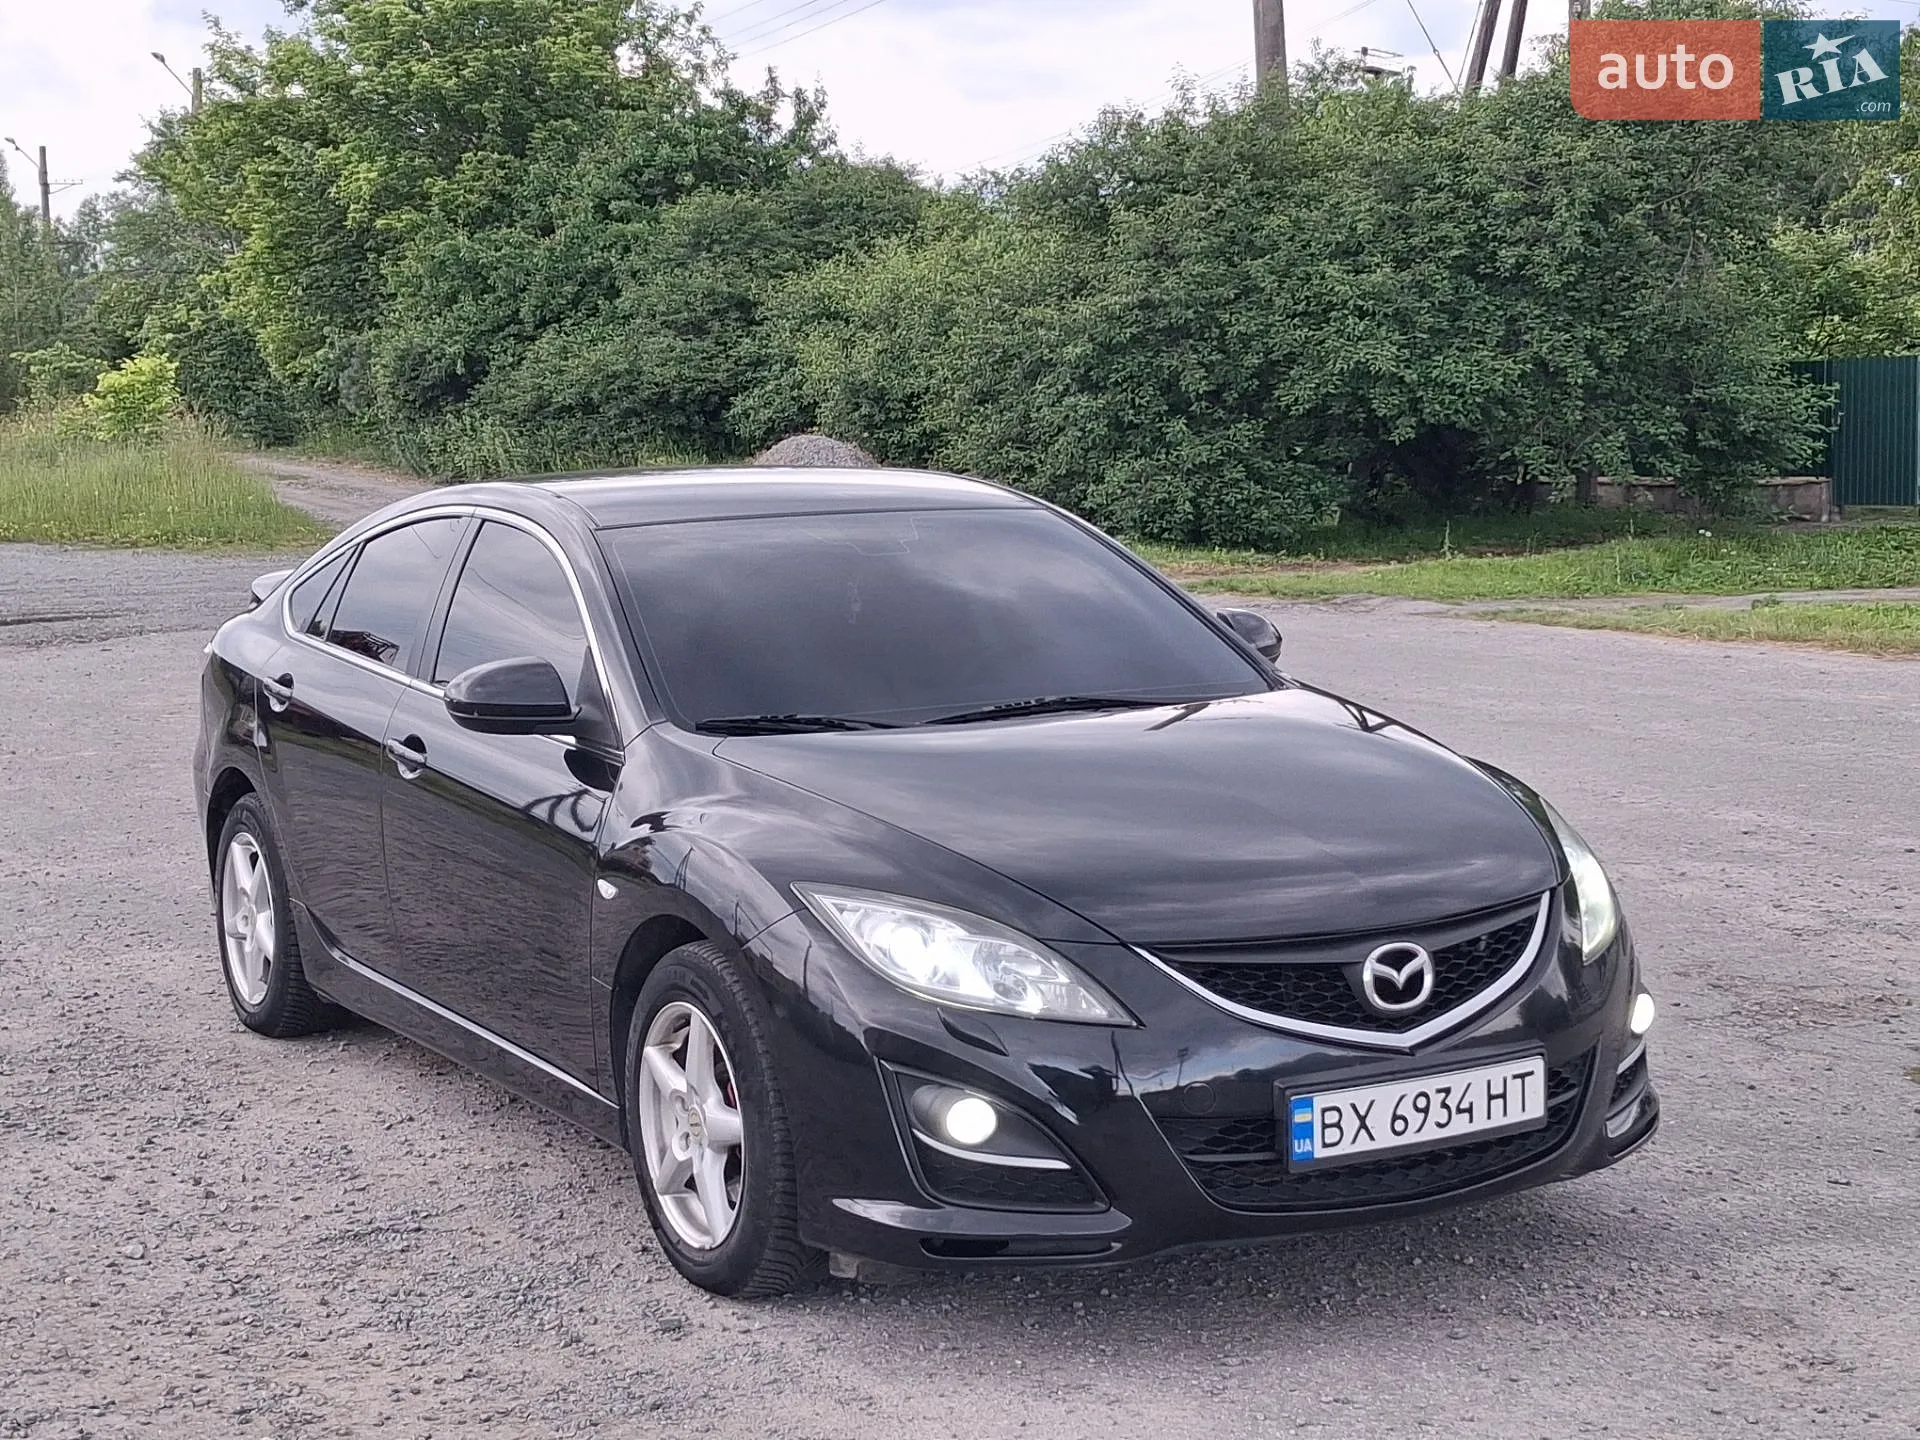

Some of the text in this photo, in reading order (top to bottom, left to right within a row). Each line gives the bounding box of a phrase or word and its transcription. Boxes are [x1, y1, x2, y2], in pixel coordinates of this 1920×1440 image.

[1320, 1070, 1535, 1149] BX 6934 HT
[1294, 1138, 1313, 1153] UA
